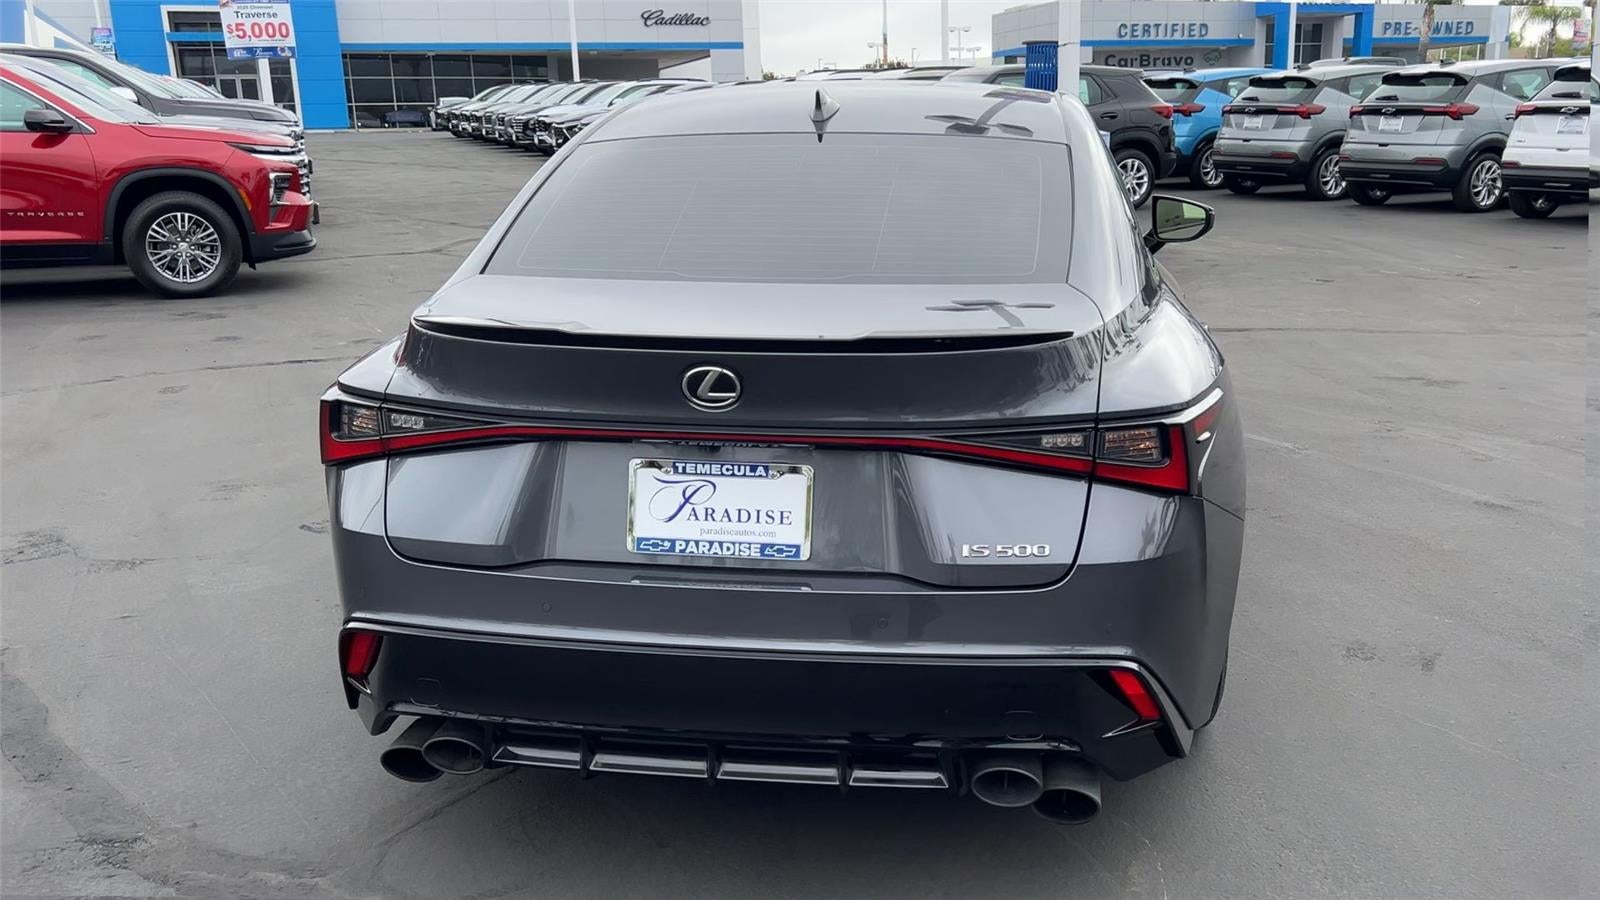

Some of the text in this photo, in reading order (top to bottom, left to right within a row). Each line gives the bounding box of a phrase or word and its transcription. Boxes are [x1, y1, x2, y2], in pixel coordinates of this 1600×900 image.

[233, 10, 278, 19] Traverse
[640, 9, 711, 27] Cadillac
[226, 21, 290, 41] $5,000
[1118, 22, 1209, 38] CERTIFIED
[1383, 21, 1474, 36] PRE-WNED
[1104, 53, 1194, 68] CarBravo
[675, 462, 767, 478] TEMECULA
[699, 526, 777, 539] paradiseautos.com
[675, 540, 762, 557] PARADISE
[962, 544, 1050, 558] IS 500
